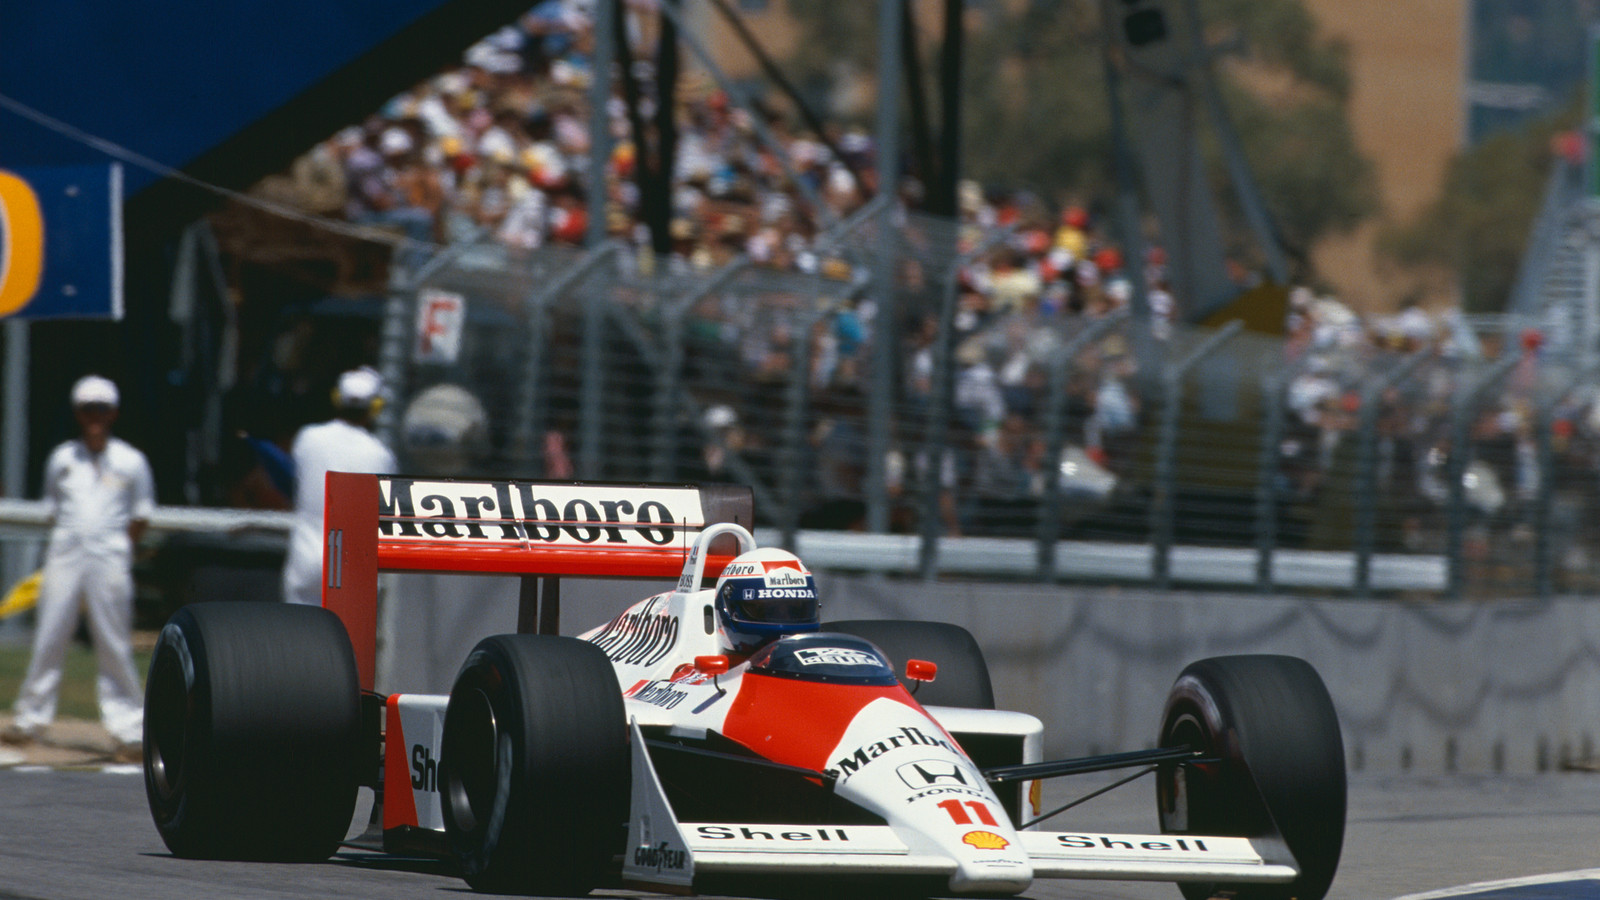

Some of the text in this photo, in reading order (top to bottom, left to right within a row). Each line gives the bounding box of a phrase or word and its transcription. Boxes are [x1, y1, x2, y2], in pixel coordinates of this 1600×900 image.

[378, 479, 675, 546] Marlboro
[328, 528, 343, 589] 11
[769, 573, 805, 585] Marlboro
[758, 589, 815, 599] HONDA
[411, 744, 441, 793] Sh
[937, 799, 1000, 827] 11
[697, 826, 849, 842] Shell
[1057, 835, 1209, 851] Shell
